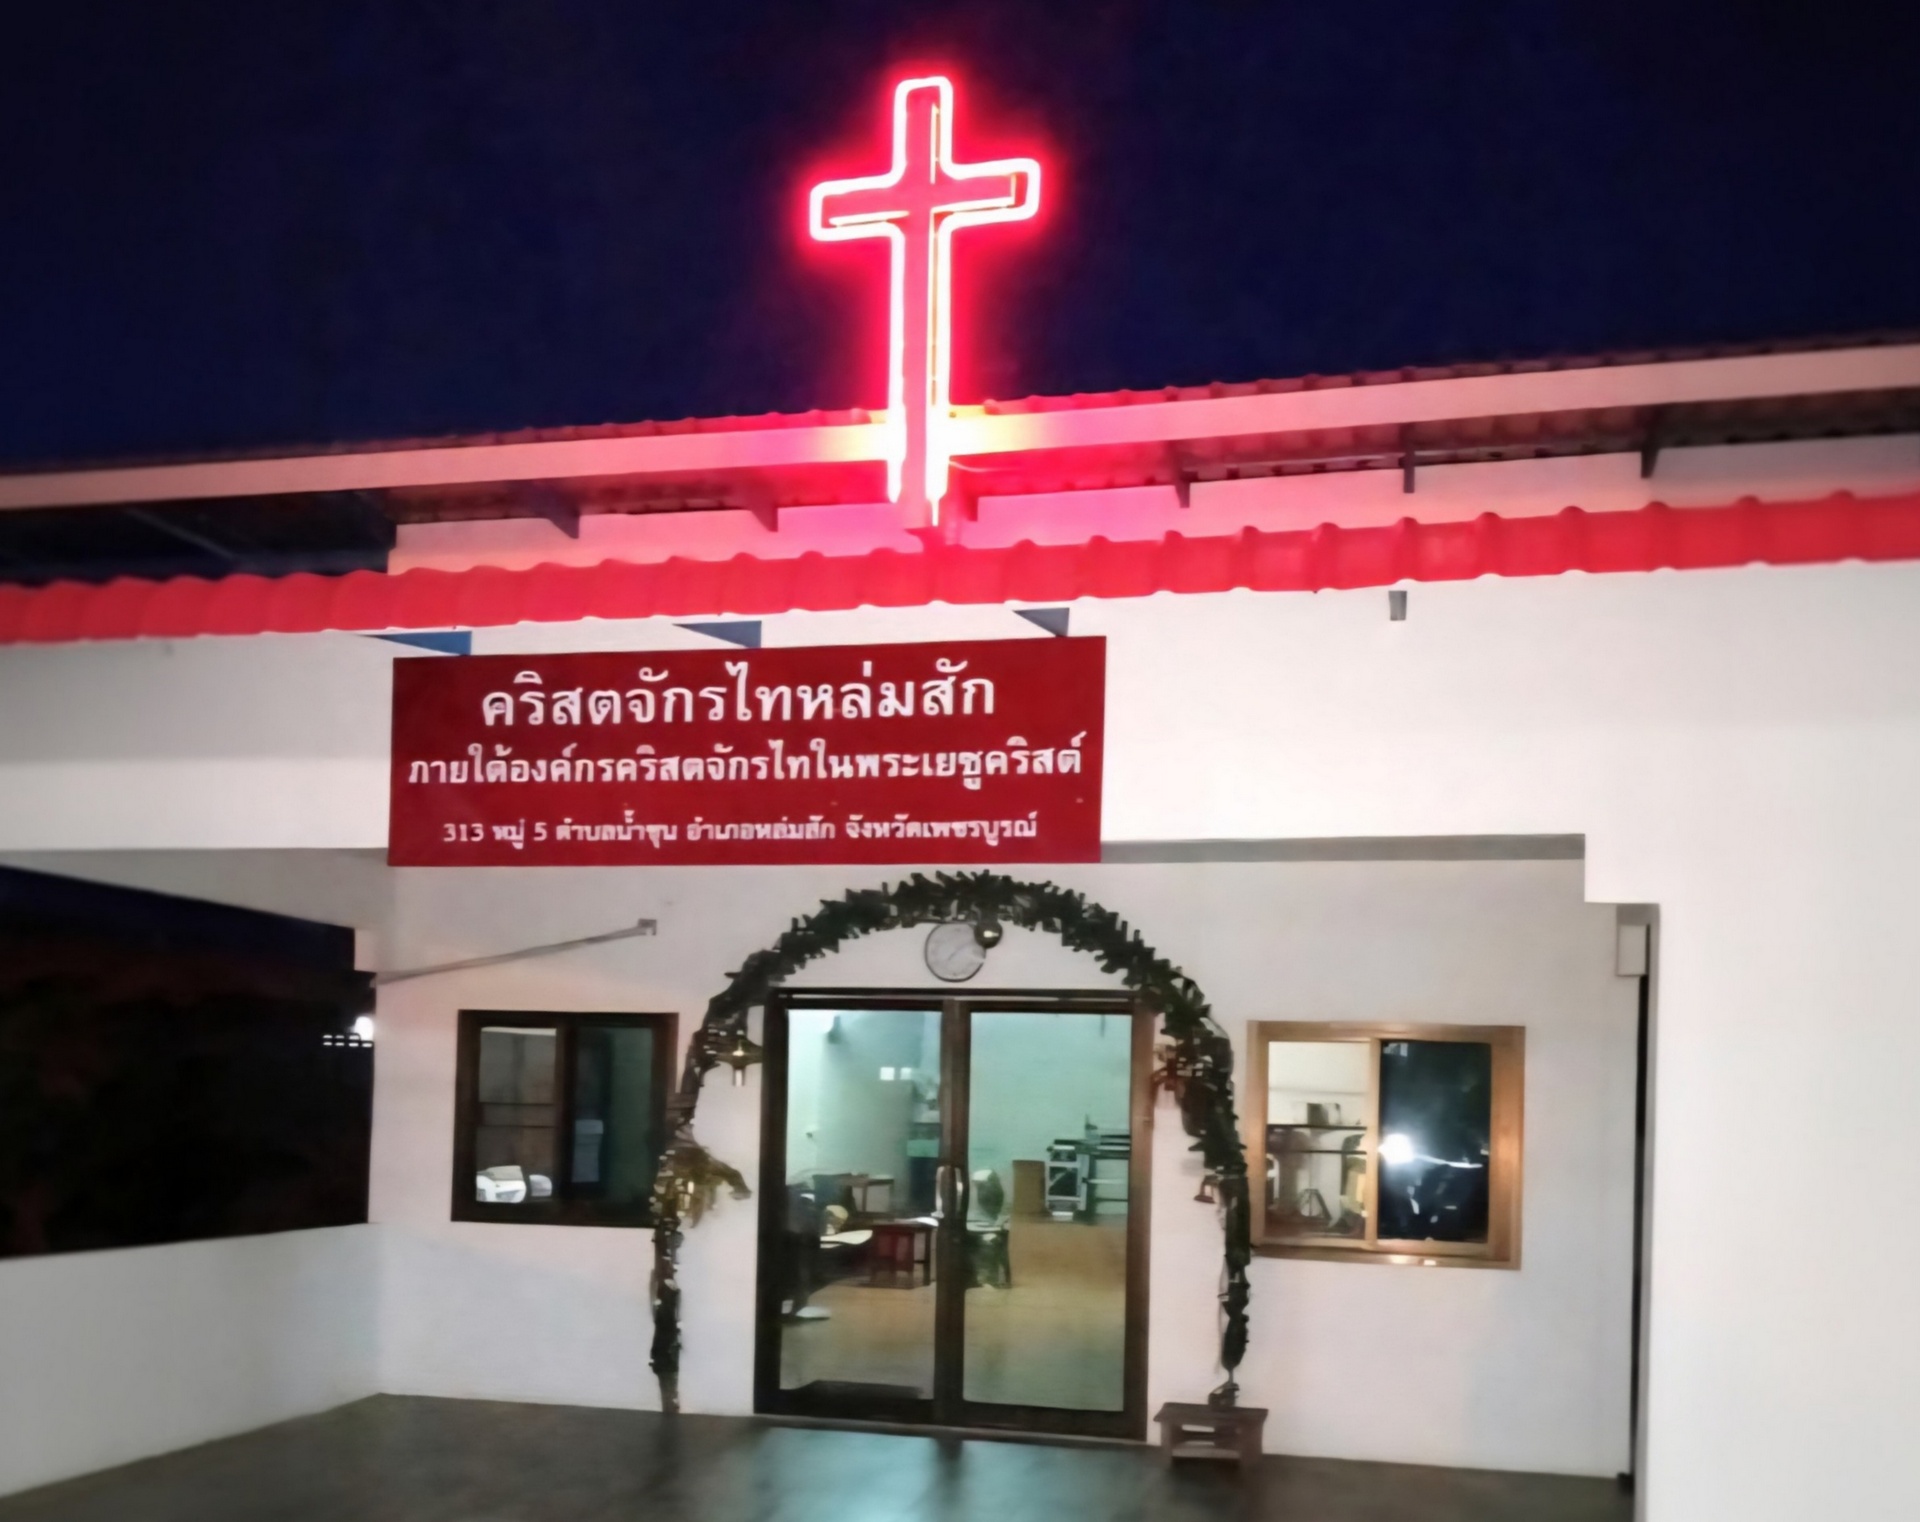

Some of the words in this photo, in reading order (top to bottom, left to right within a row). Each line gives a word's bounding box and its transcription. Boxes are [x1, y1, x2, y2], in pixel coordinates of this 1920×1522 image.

[481, 657, 996, 726] คริสตจักรไทหล่มสัก
[443, 823, 485, 843] 313
[491, 818, 526, 850] หมู่
[533, 822, 548, 842] 5
[845, 810, 1039, 847] จังหวัดเพชรบูรณ์
